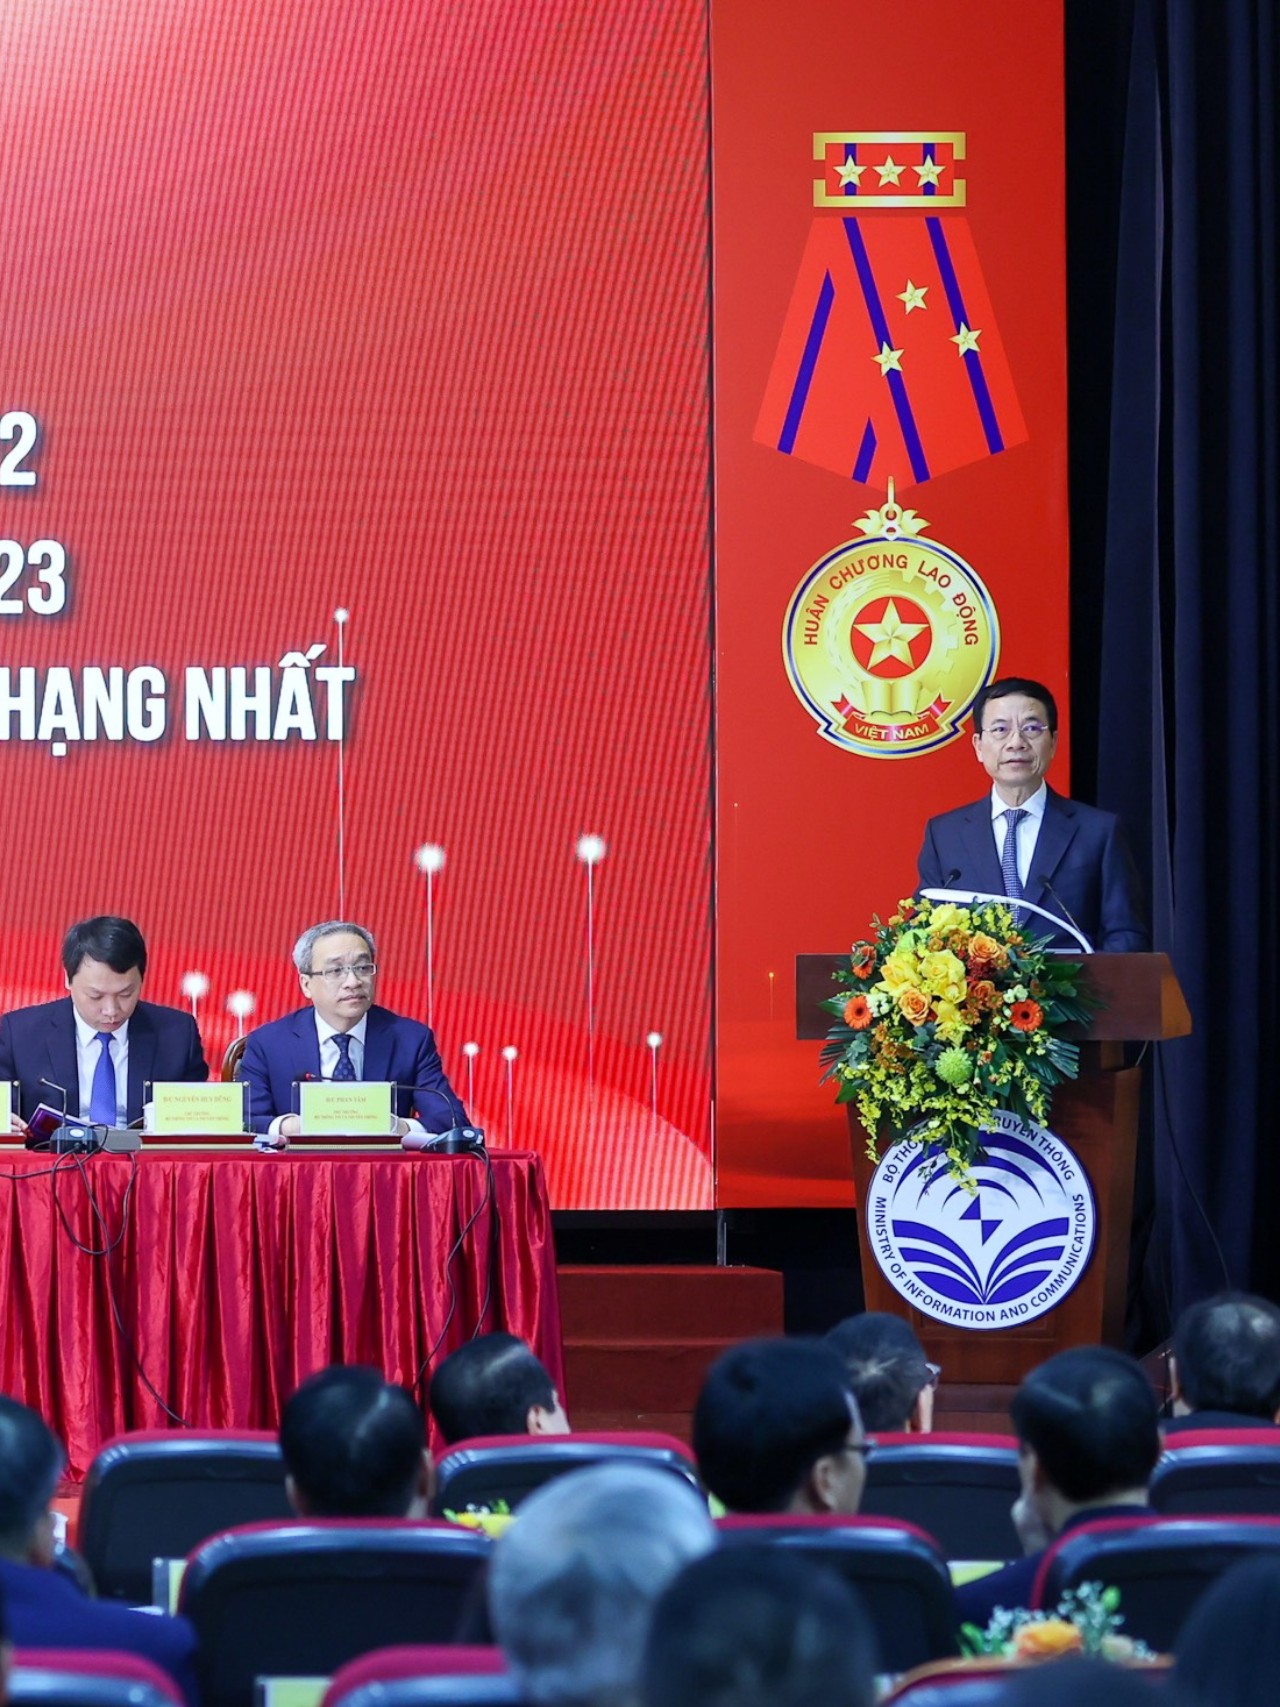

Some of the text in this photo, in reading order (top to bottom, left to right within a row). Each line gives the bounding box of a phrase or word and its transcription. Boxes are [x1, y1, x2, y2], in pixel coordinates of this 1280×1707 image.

[804, 553, 979, 646] HUÂN CHƯƠNG LAO ĐỘNG
[185, 644, 356, 741] NHẤT
[853, 722, 929, 741] VIỆT NAM
[882, 1164, 901, 1183] BỘ
[875, 1193, 1087, 1322] MINISTRY OF INFORMATION AND COMMUNICATIONS
